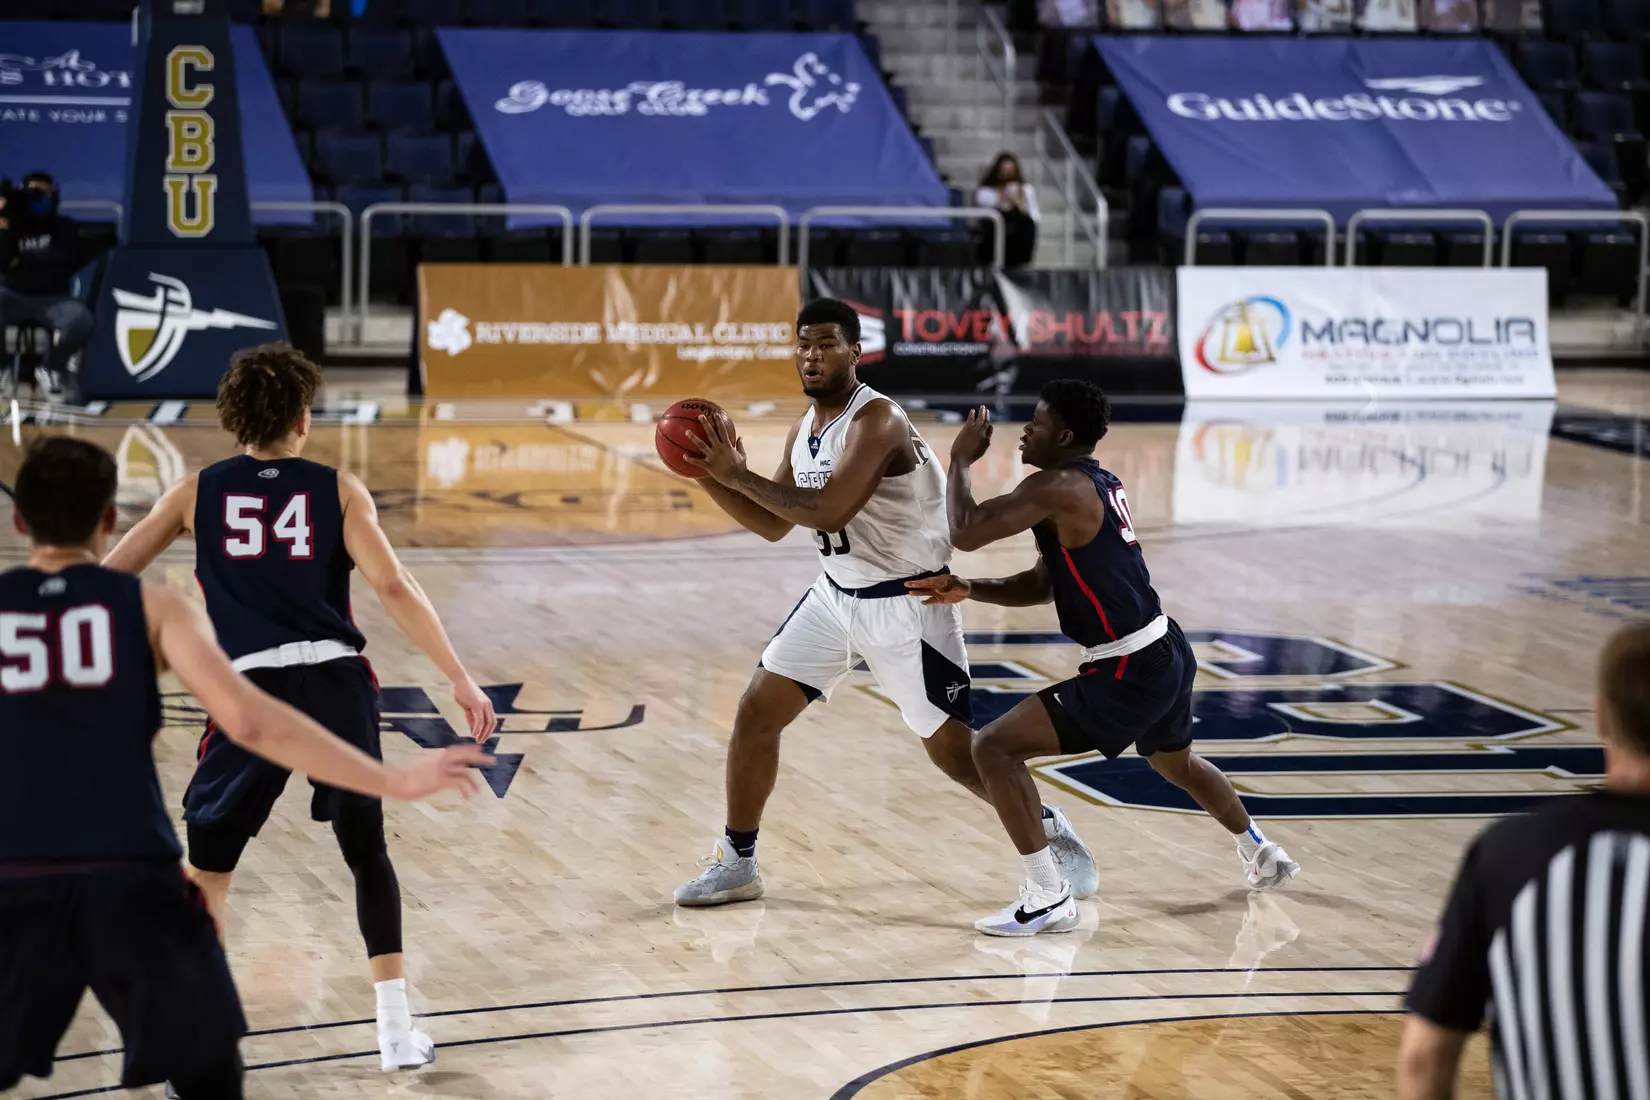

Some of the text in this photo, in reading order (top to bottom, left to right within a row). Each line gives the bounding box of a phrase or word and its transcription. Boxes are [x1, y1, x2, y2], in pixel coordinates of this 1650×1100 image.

[1166, 91, 1507, 122] GuideStone
[164, 45, 217, 237] CBU
[474, 320, 794, 344] RIVERSIDE MEDICAL CLINIC
[1301, 317, 1536, 346] MAGNOLIA
[222, 491, 315, 561] 54
[0, 602, 115, 695] 50
